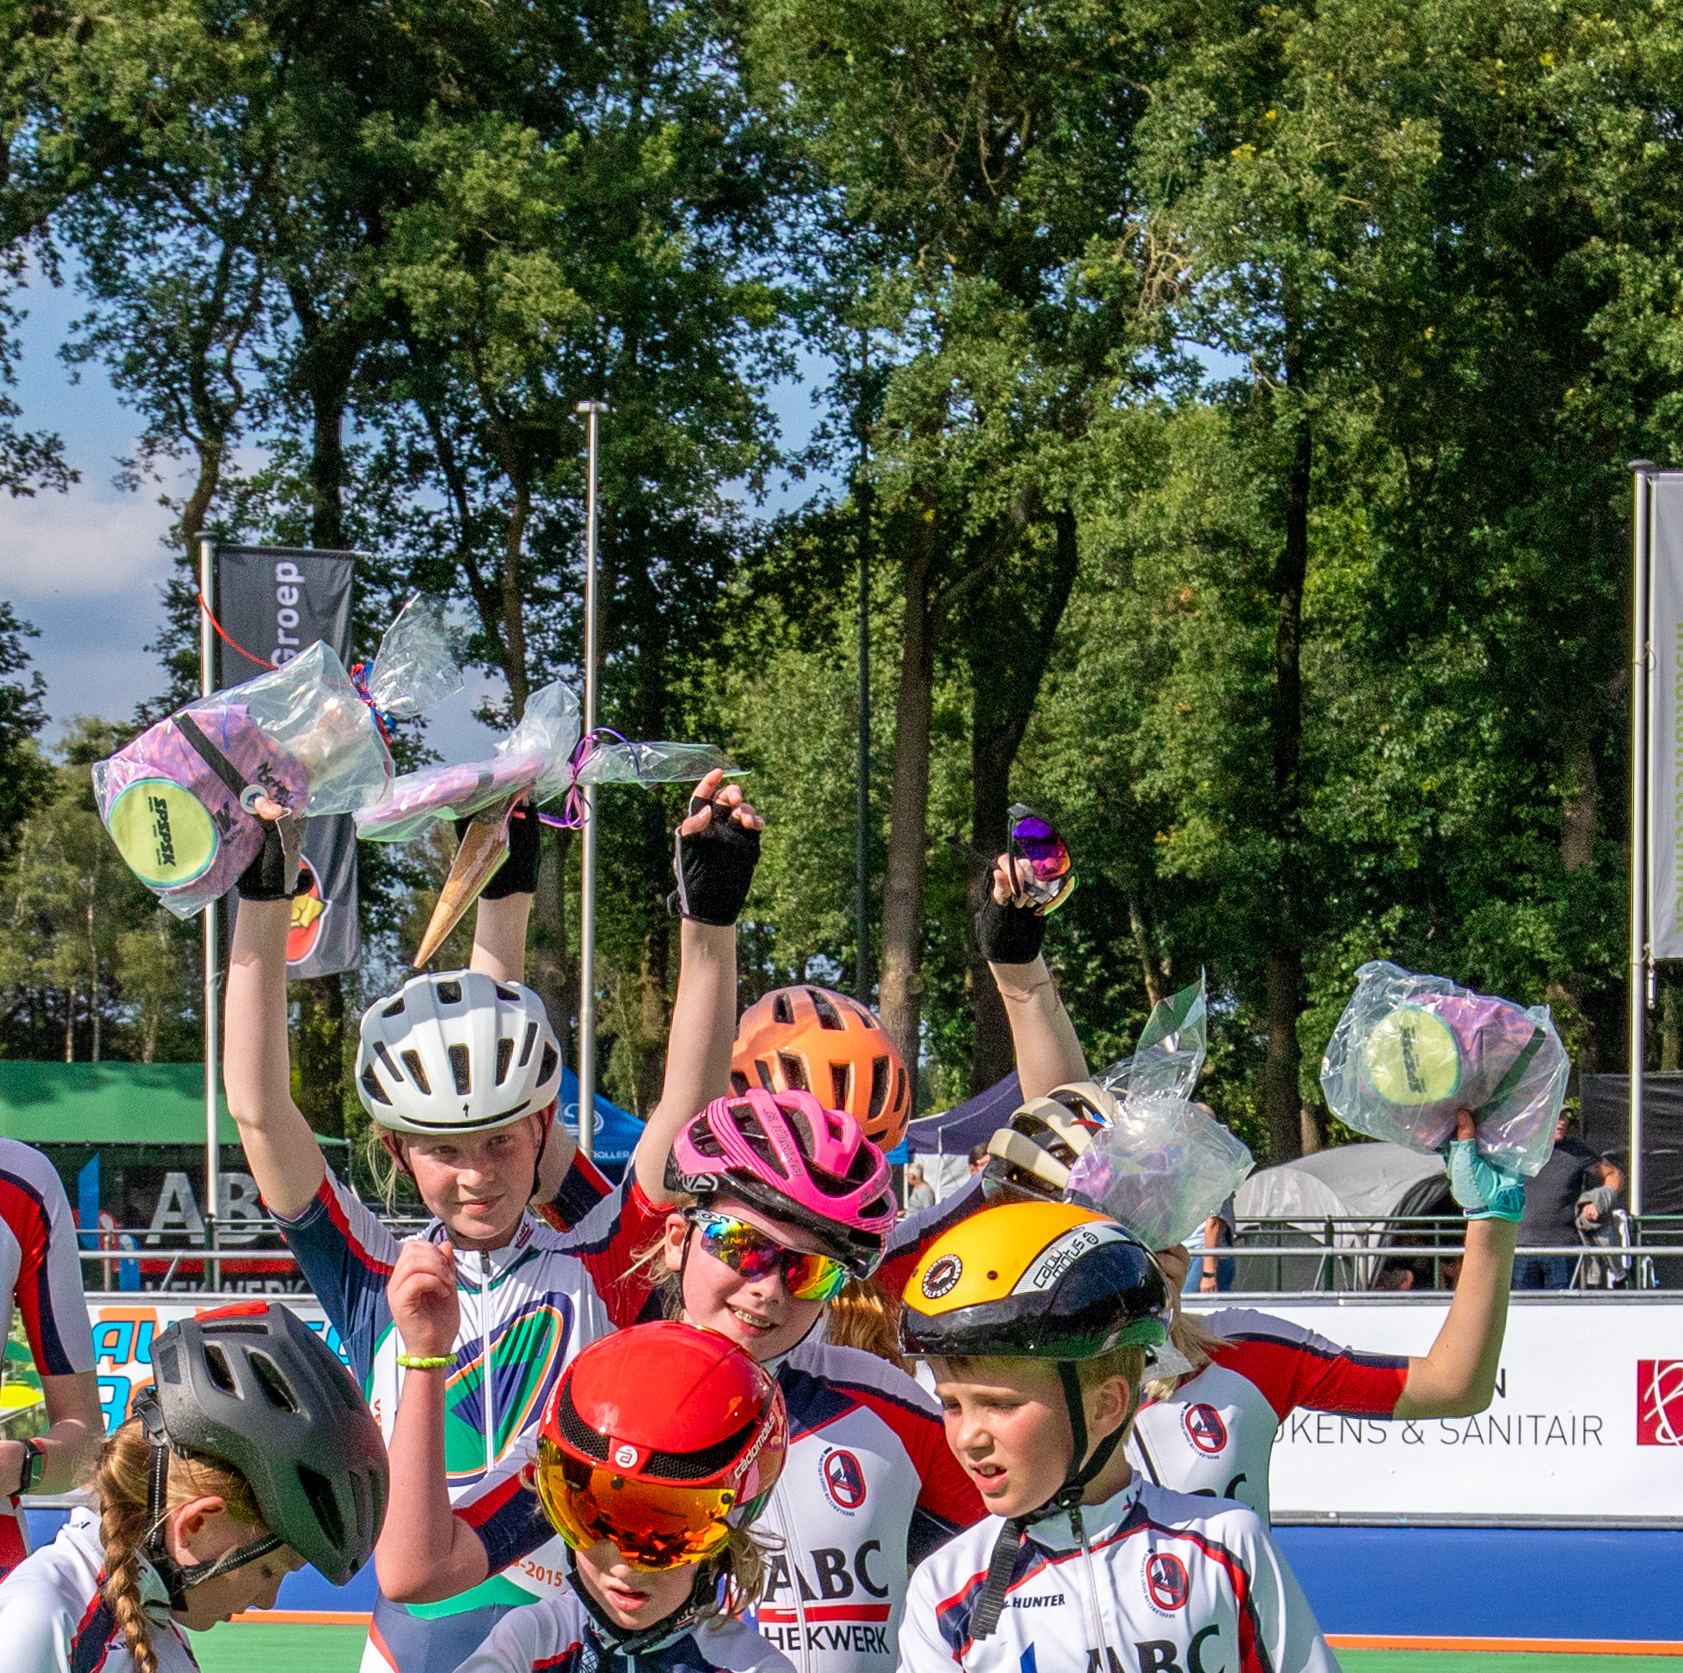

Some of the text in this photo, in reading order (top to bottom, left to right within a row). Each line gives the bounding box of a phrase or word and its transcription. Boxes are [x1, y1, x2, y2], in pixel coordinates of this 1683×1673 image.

[145, 1171, 265, 1244] AB
[1400, 1417, 1425, 1445] &
[1440, 1413, 1604, 1446] SANITAIR
[763, 1540, 890, 1602] ABC
[1012, 1593, 1066, 1609] HUNTER
[764, 1624, 890, 1655] HEKWERK
